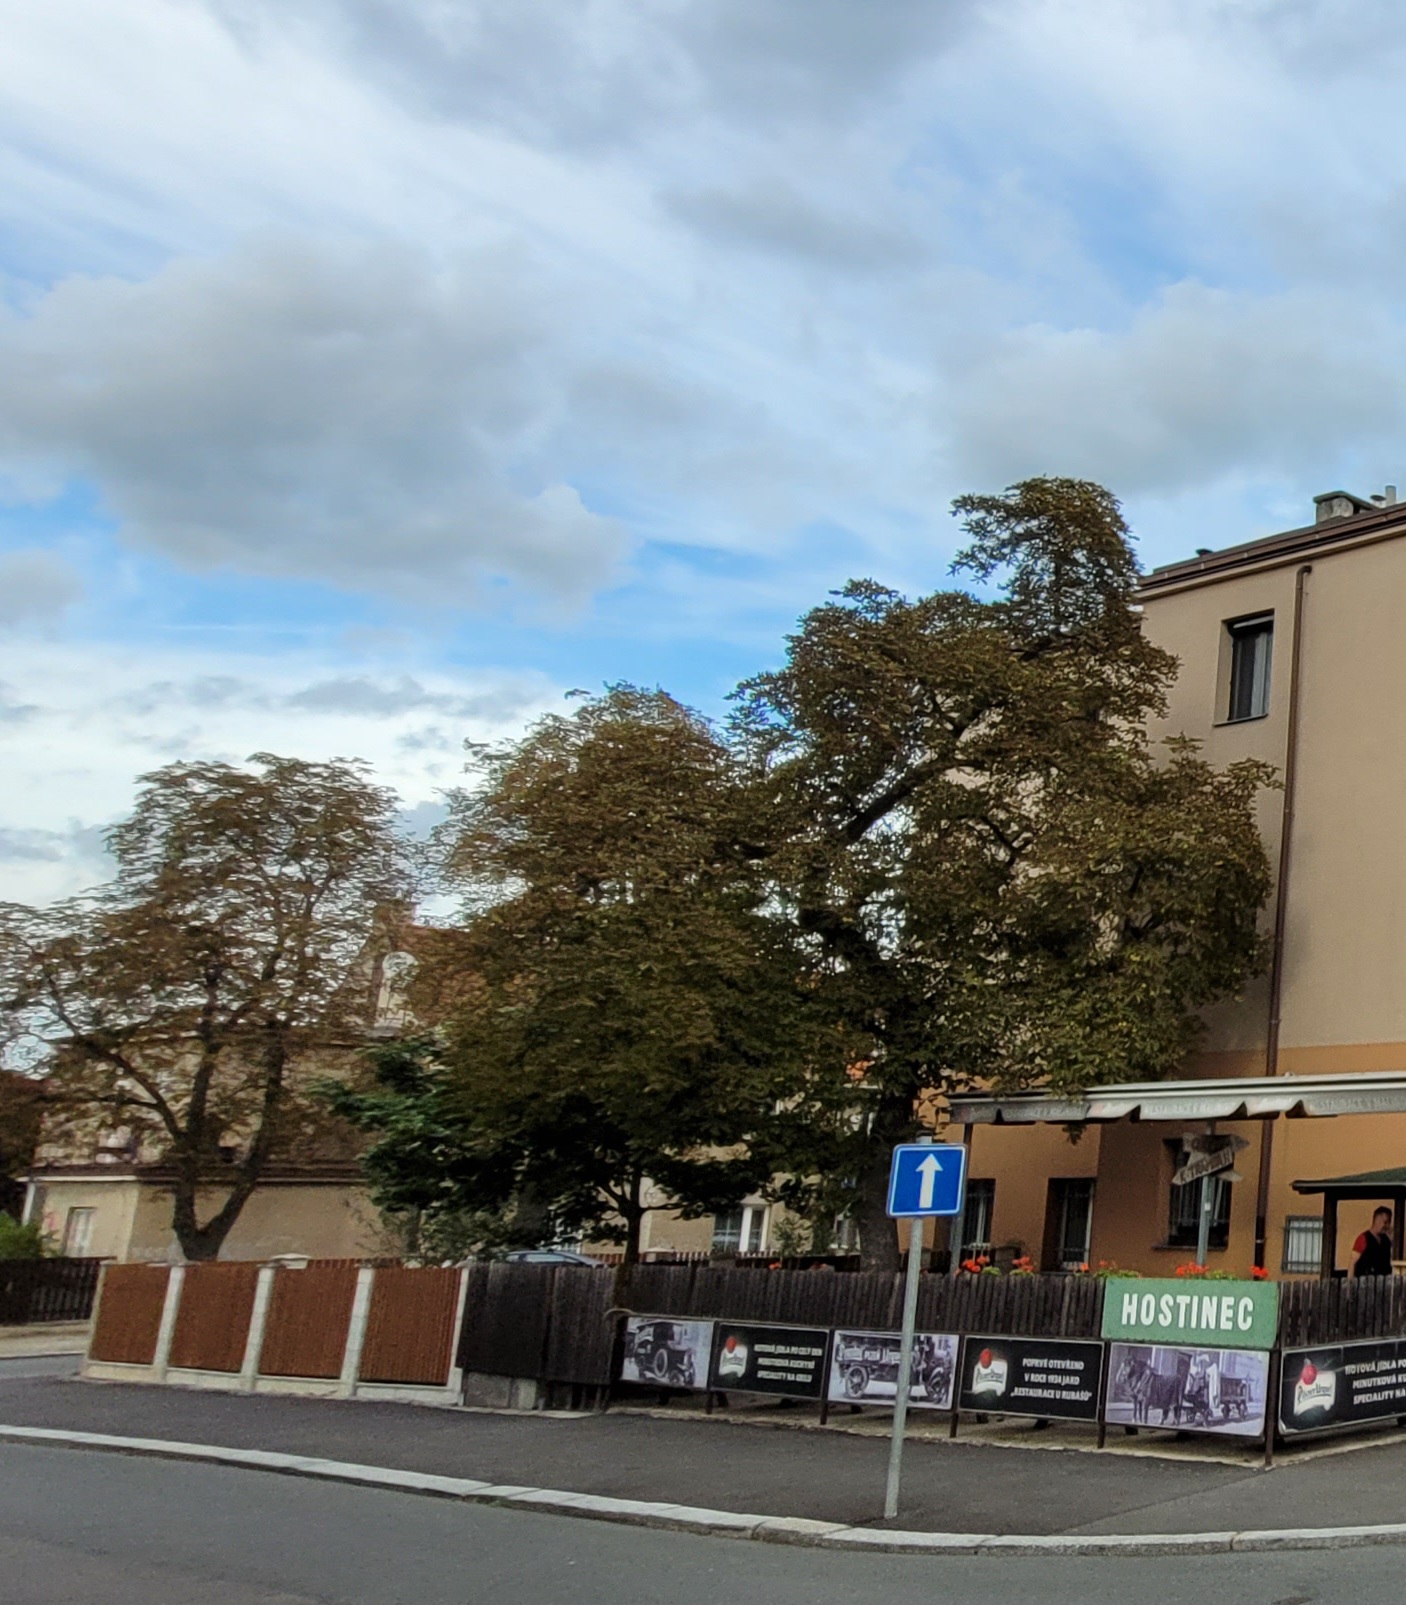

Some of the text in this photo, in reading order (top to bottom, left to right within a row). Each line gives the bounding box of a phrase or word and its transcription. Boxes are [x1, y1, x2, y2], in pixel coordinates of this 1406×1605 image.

[1121, 1293, 1254, 1331] HOSTINEC
[1022, 1358, 1085, 1370] POPRVÉ OTEVŘENO
[1345, 1360, 1376, 1376] HOTOVÁ
[1376, 1359, 1397, 1373] JÍDLA
[1397, 1359, 1406, 1369] PO
[1024, 1373, 1030, 1382] V
[1030, 1373, 1047, 1383] ROCE
[1061, 1375, 1080, 1386] JAKO
[1352, 1373, 1397, 1390] MINUTKOVÁ
[1056, 1389, 1061, 1399] U
[1353, 1389, 1395, 1405] SPECIALITY
[1395, 1389, 1406, 1398] NA
